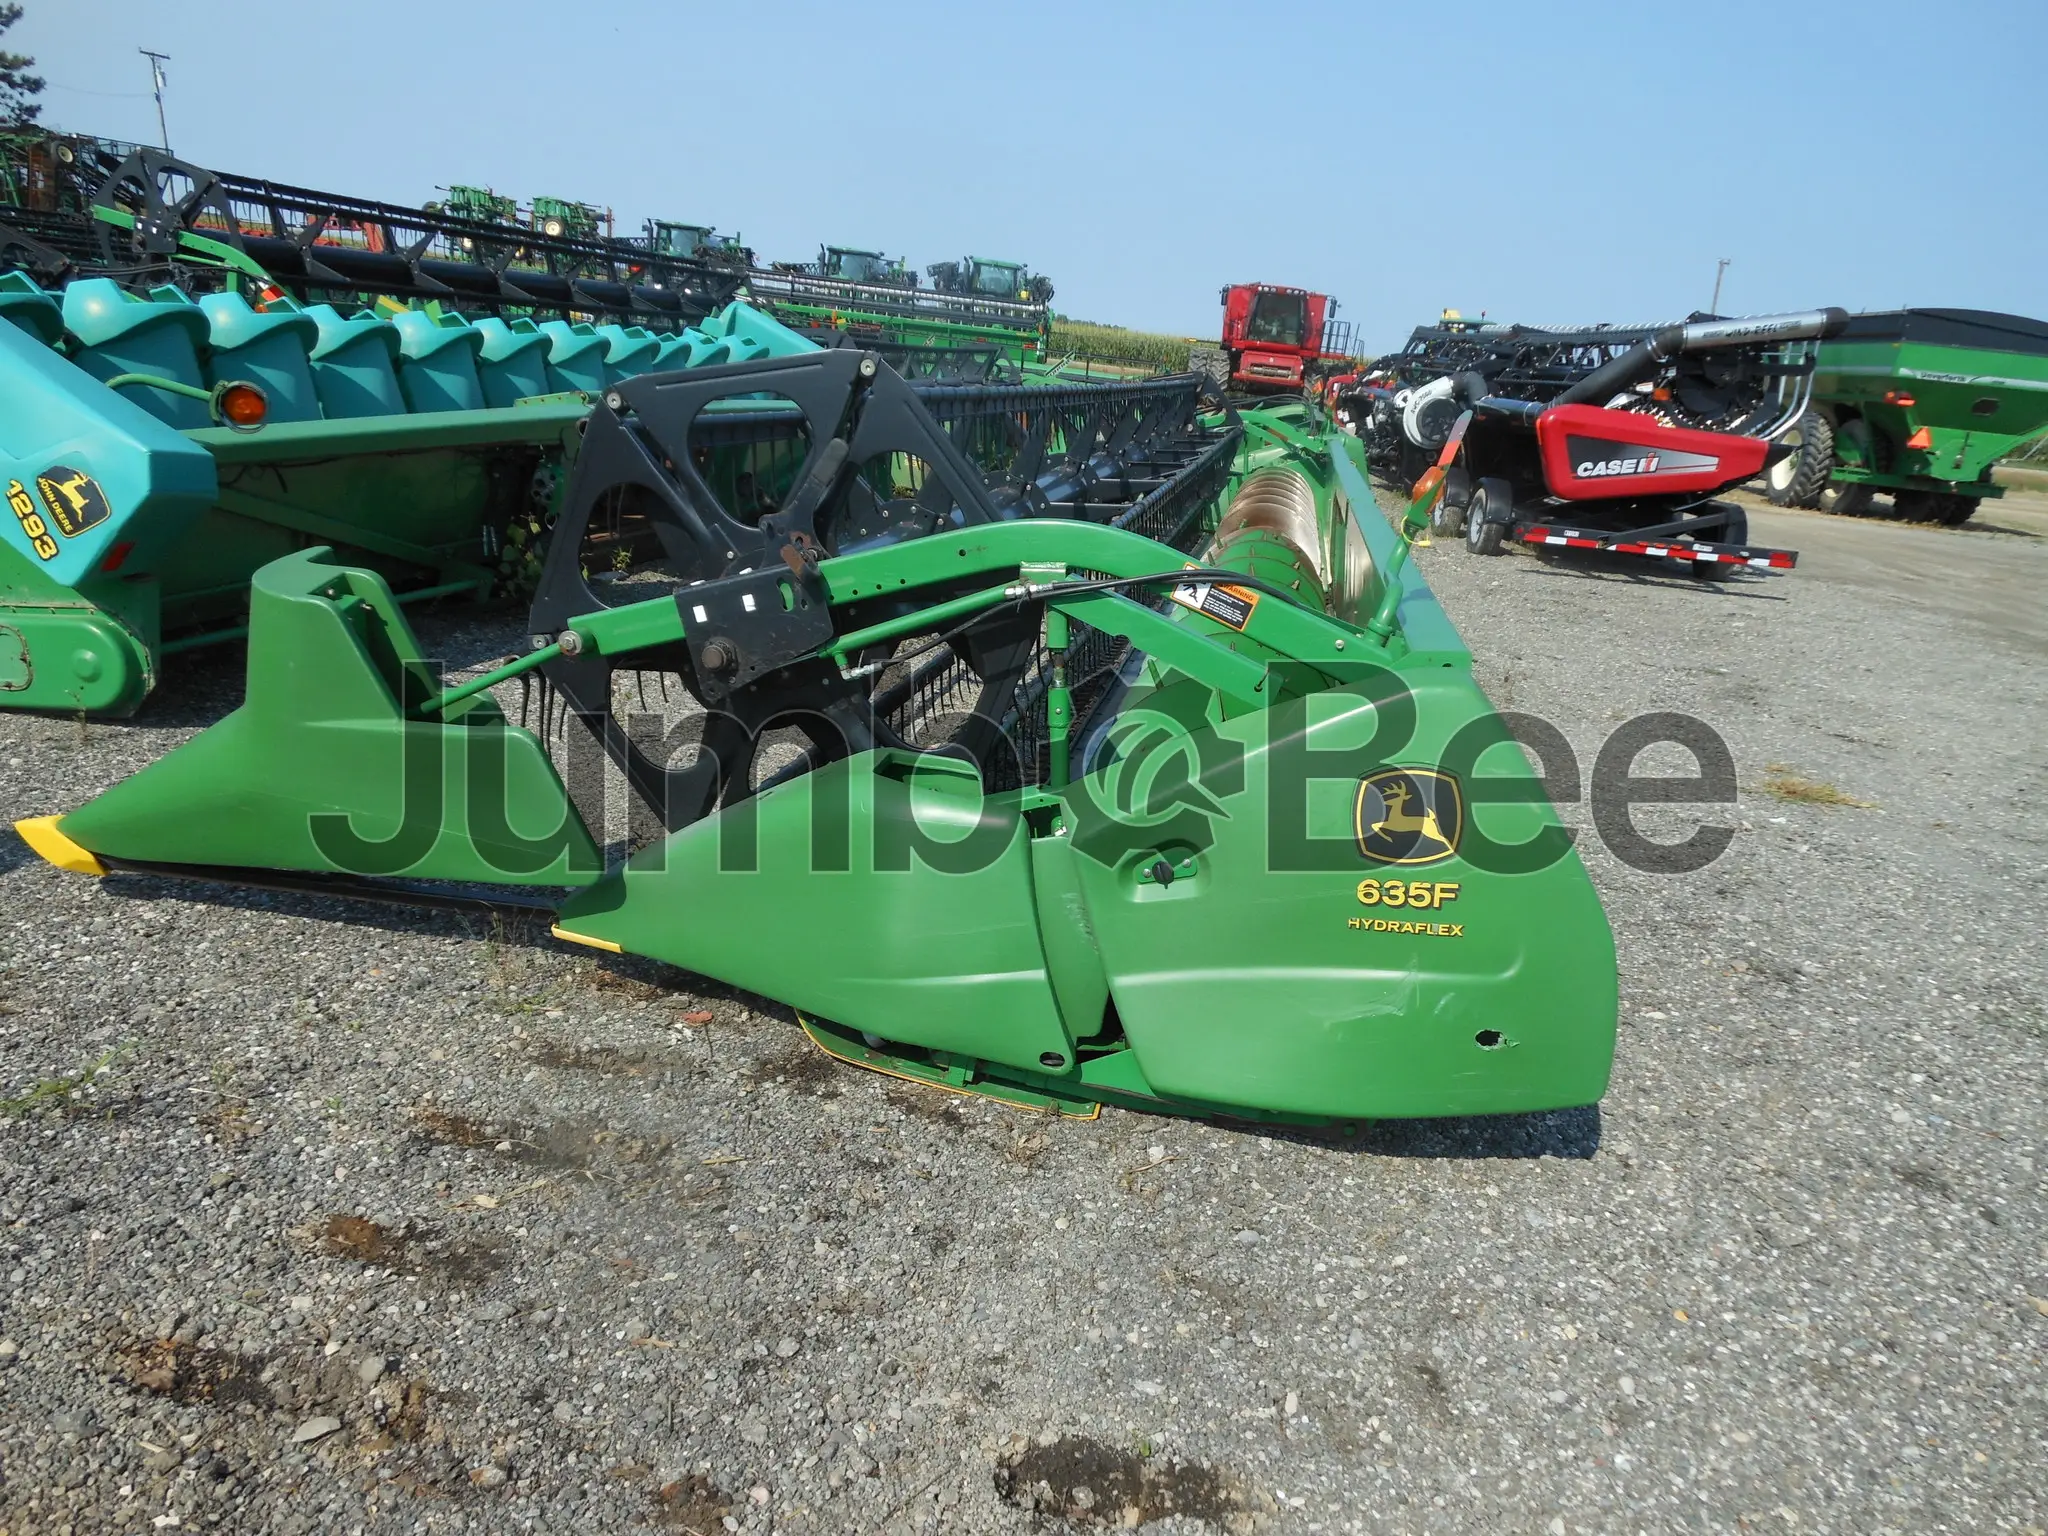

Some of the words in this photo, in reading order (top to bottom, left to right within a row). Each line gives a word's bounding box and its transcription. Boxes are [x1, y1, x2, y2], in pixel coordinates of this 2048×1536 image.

[6, 478, 59, 561] 1293
[38, 477, 56, 503] JOHN
[51, 501, 74, 534] DEERE
[1356, 878, 1460, 909] 635F
[1348, 917, 1464, 938] HYDRAFLEX
